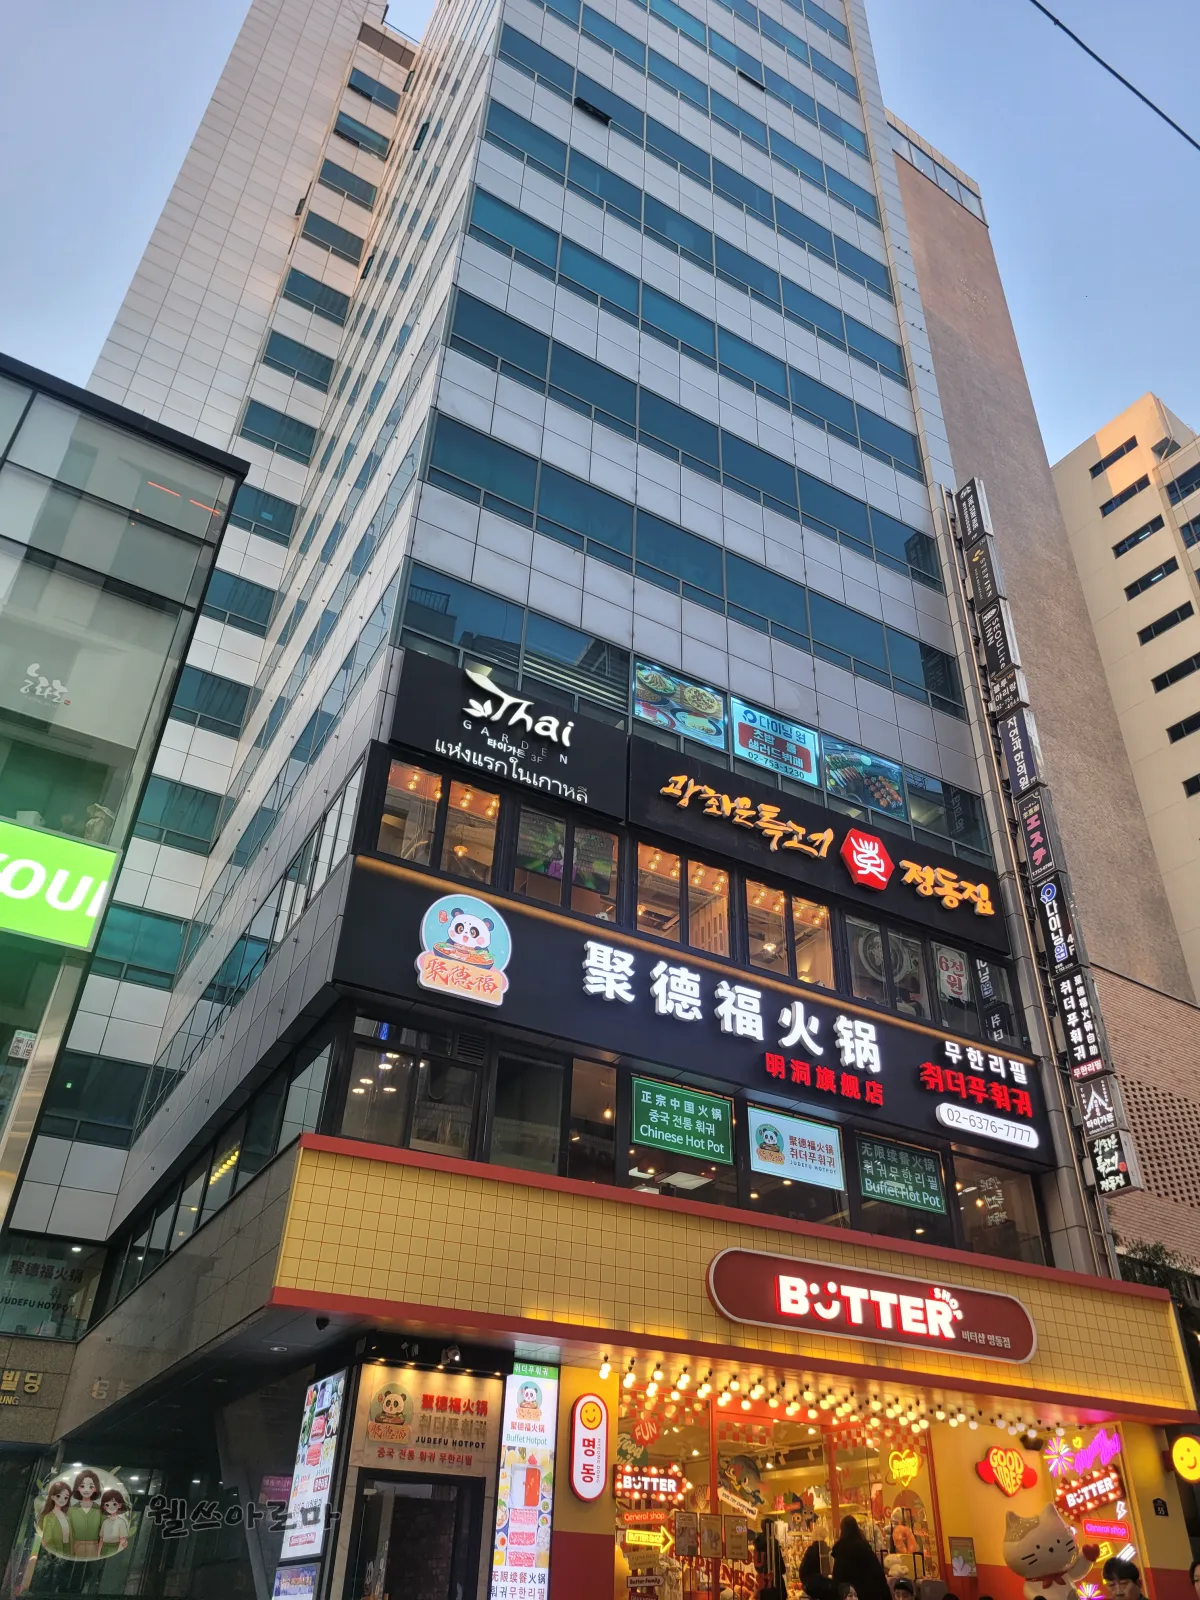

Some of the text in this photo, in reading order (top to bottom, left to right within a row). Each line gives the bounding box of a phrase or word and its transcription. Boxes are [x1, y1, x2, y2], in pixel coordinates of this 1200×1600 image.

[985, 580, 993, 598] INN
[985, 622, 994, 647] INN
[991, 617, 1006, 669] SEOULite
[463, 668, 575, 747] Thai
[463, 719, 568, 765] GARDEN
[487, 737, 525, 759] 타이가든
[747, 751, 805, 781] 02-753-1230
[1026, 814, 1047, 867] エステ
[899, 858, 997, 919] 정동집
[583, 940, 883, 1076] 聚德福火锅
[1060, 978, 1087, 1061] 취더푸훠궈
[943, 1039, 1029, 1086] 무한리필
[1073, 1059, 1103, 1080] 무한리필
[764, 1051, 884, 1108] 明洞旗舰店
[919, 1061, 1033, 1118] 취더푸훠궈
[640, 1090, 722, 1122] 正宗中国火锅
[648, 1109, 716, 1138] 중국 전통 훠궈
[946, 1107, 1032, 1144] 02-6376-7777
[640, 1124, 725, 1155] Chinese Hot Pot
[788, 1135, 835, 1156] 聚德福火锅
[788, 1147, 836, 1168] 취더푸훠궈
[814, 1165, 838, 1176] HOTPOT
[864, 1178, 942, 1209] Buffet Hot Pot
[37, 1301, 74, 1312] HOTPOT
[774, 1274, 957, 1341] BUTTER
[931, 1286, 964, 1321] SHOP
[961, 1330, 1011, 1350] 버터샵 명동점
[1, 1370, 43, 1393] 빌딩
[421, 1393, 489, 1416] 聚德福火锅
[418, 1413, 488, 1437] 취더푸훠궈
[635, 1421, 657, 1441] FUN
[415, 1436, 486, 1450] JUDEFU HOTPOT
[506, 1434, 548, 1447] Buffet Hotpot
[377, 1447, 395, 1459] 중국
[419, 1451, 437, 1464] 훠궈
[439, 1452, 473, 1467] 무한리필
[581, 1437, 596, 1484] 명동
[989, 1447, 1024, 1474] GOOD
[622, 1475, 677, 1493] BUTTER
[993, 1466, 1023, 1494] VIBES
[1066, 1476, 1114, 1508] BUTTER
[624, 1512, 648, 1522] General
[649, 1511, 666, 1521] shop
